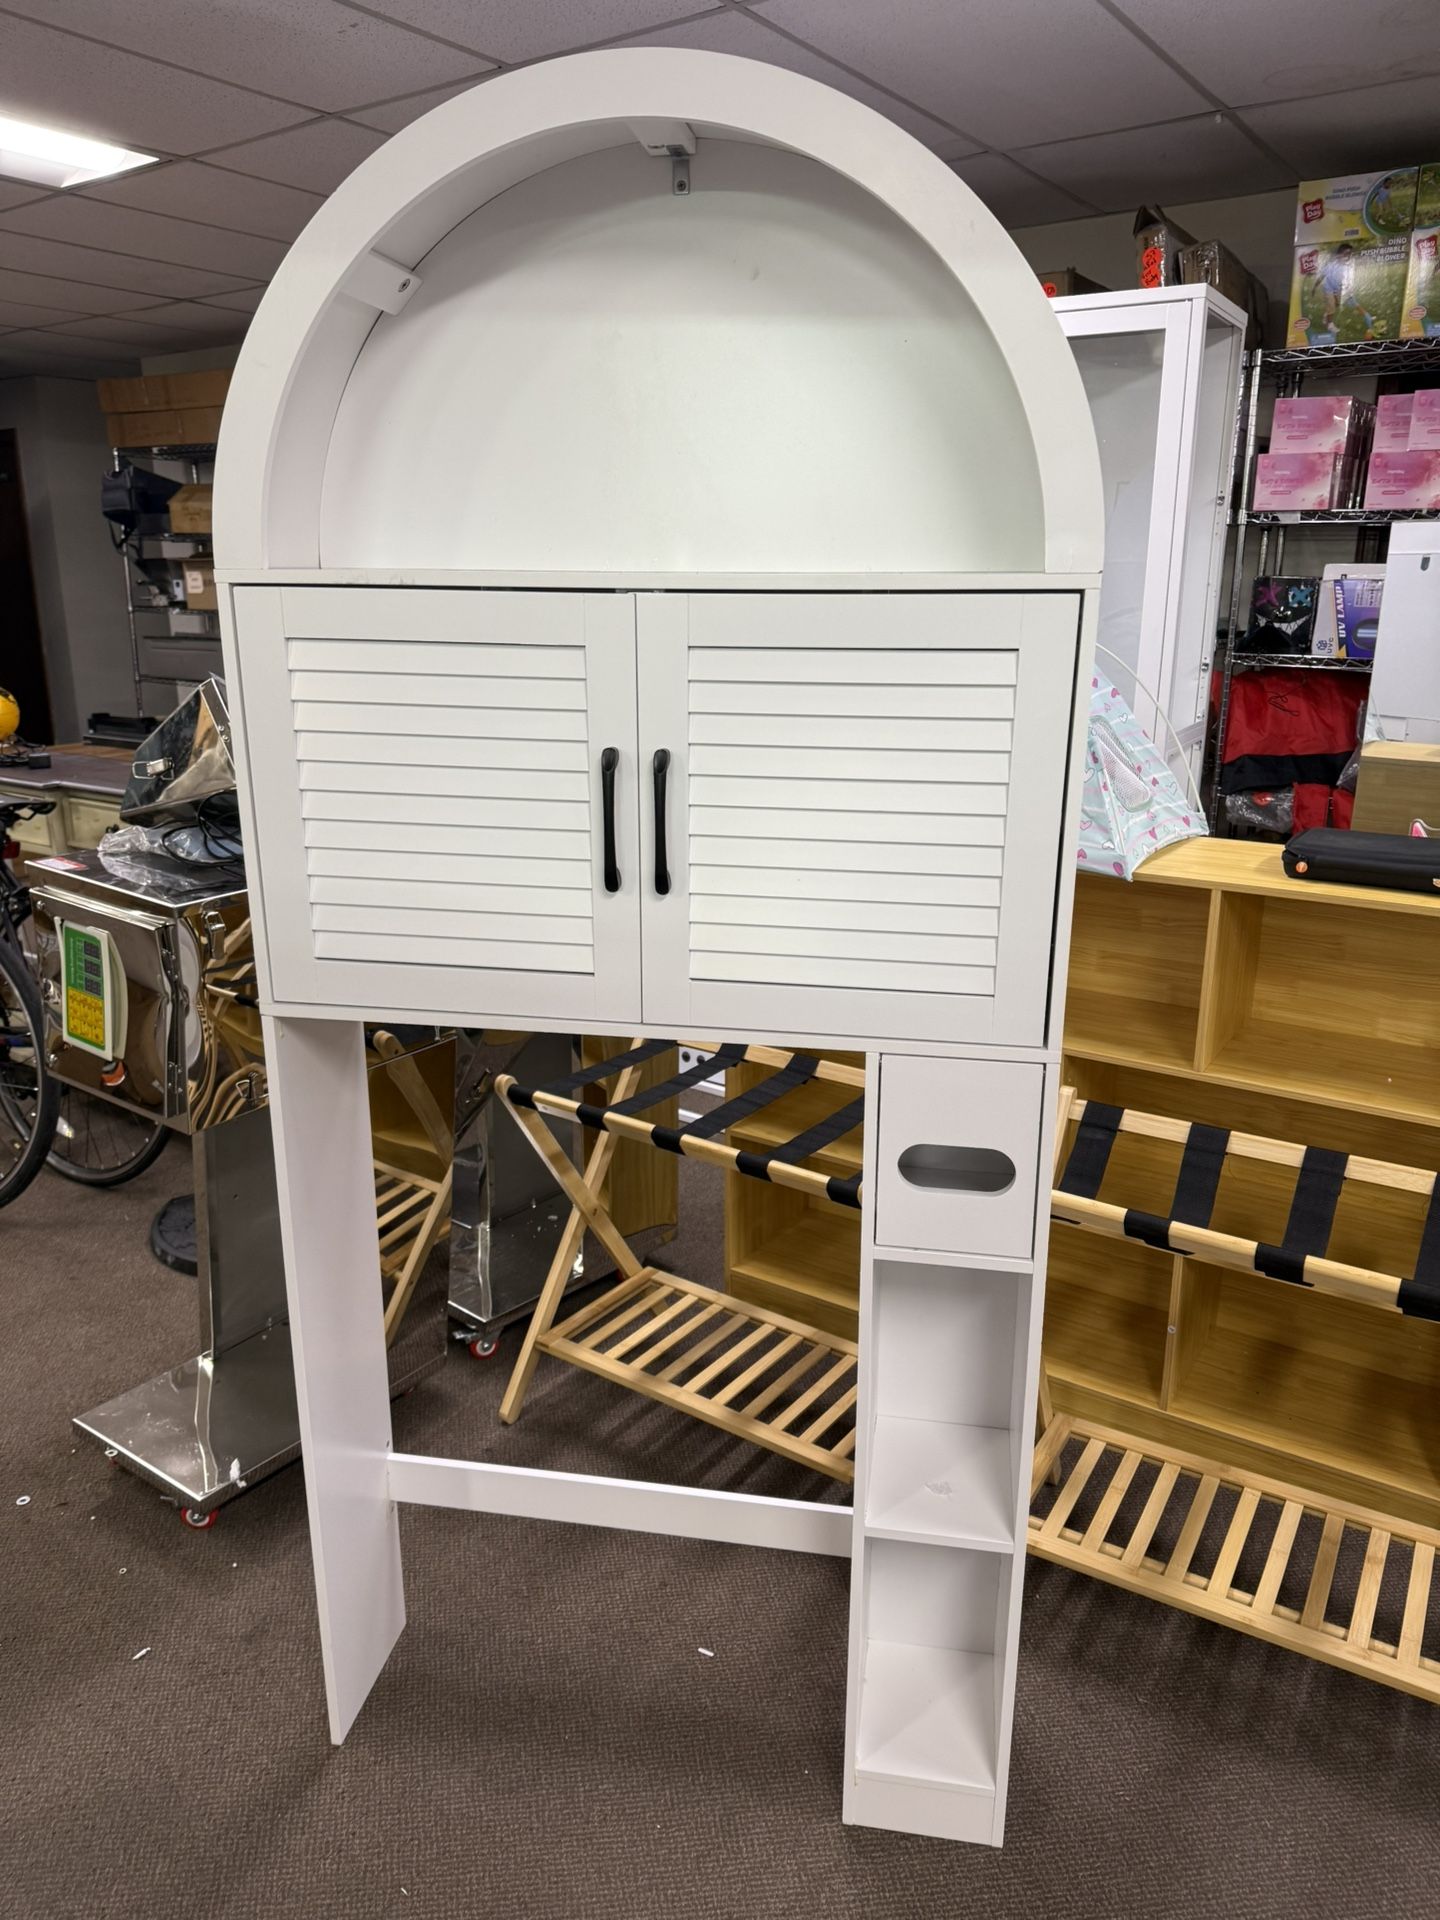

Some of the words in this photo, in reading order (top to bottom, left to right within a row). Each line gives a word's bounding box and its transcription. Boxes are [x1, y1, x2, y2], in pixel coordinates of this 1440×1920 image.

[1305, 203, 1321, 212] Play
[1306, 209, 1321, 218] Day
[1388, 237, 1407, 245] DINO
[1360, 248, 1380, 256] PUSH
[1379, 246, 1406, 254] BUBBLE
[1376, 253, 1406, 262] BLOWER
[1335, 586, 1345, 618] LAMP
[1338, 622, 1346, 637] UV
